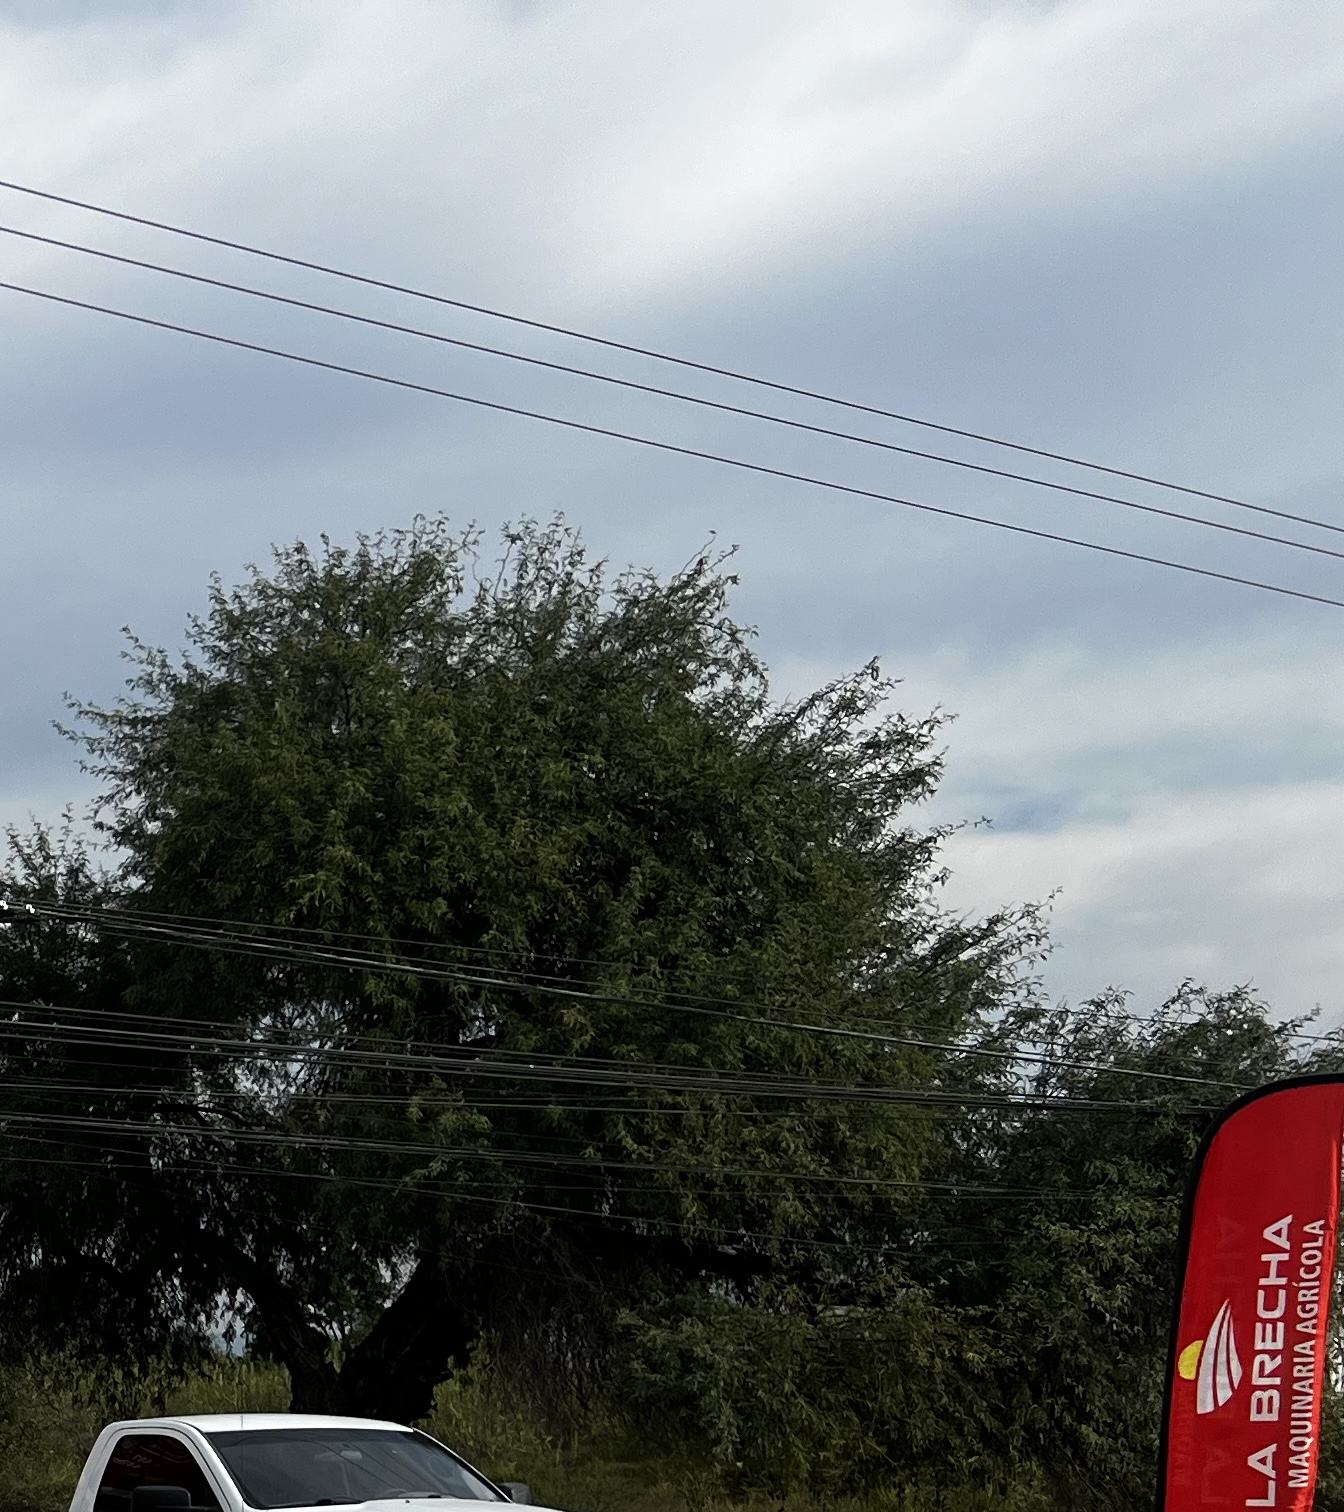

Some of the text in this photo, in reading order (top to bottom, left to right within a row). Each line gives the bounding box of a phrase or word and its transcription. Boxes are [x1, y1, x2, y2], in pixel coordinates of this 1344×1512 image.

[1245, 1214, 1294, 1507] LA BRECHA
[1287, 1219, 1326, 1488] MAQUINARIA AGRÍCOLA
